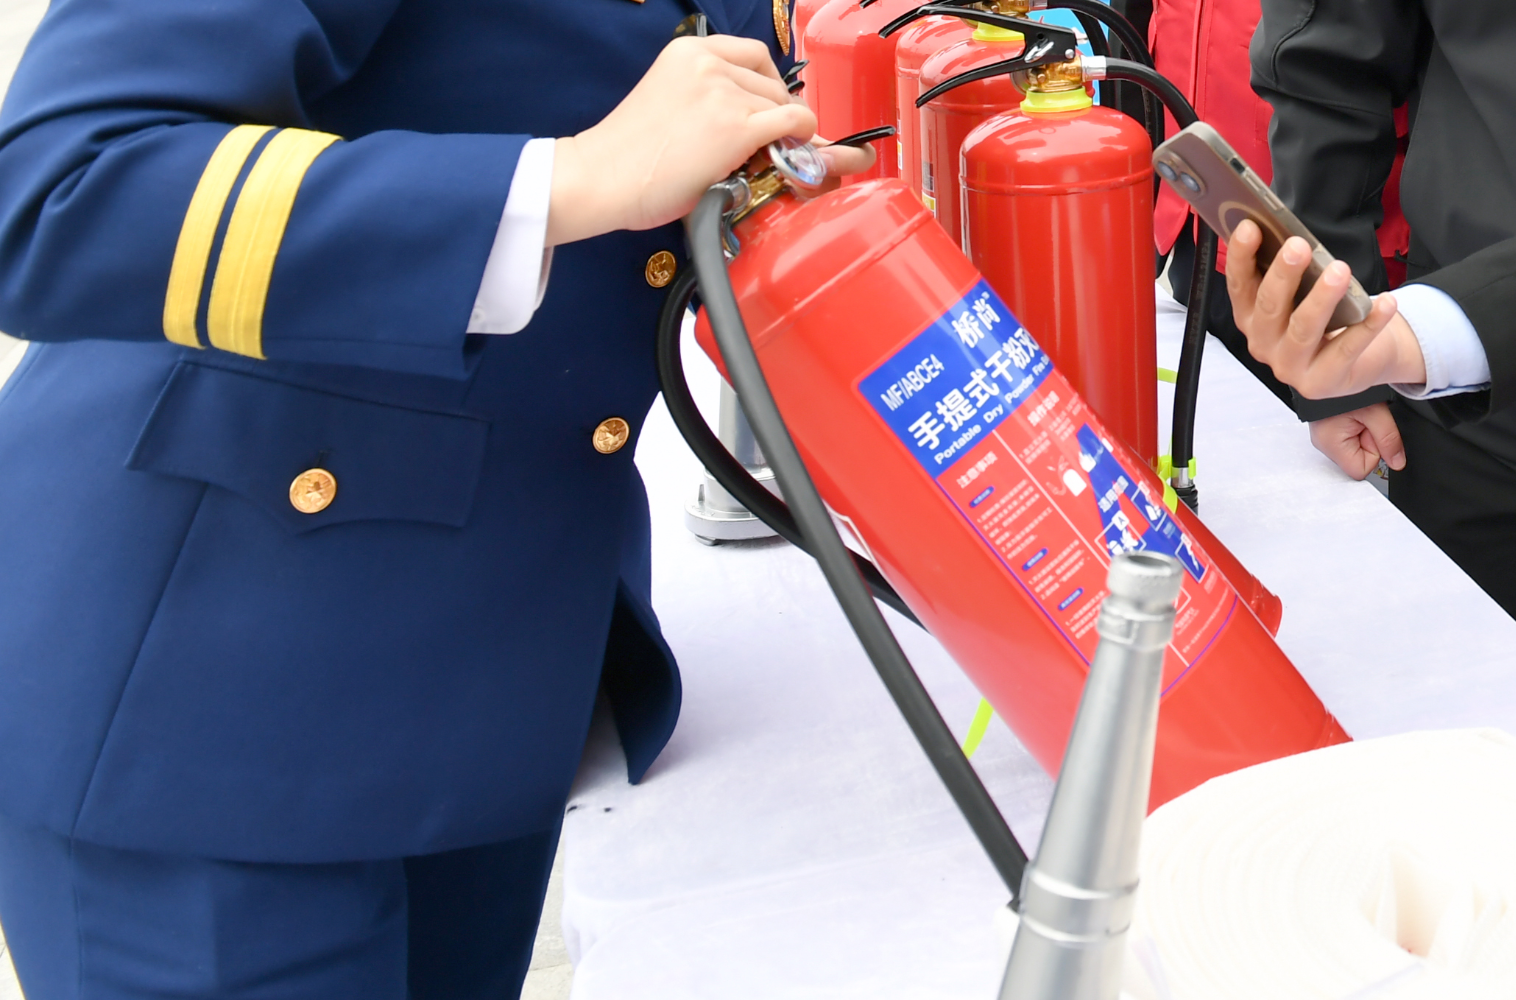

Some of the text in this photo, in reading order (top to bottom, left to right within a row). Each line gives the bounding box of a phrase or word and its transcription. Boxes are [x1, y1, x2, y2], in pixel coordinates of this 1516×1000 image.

[880, 353, 945, 412] MF/ABCE4
[933, 424, 982, 465] Portable
[983, 403, 1004, 423] Dry
[1004, 373, 1035, 404] Powder
